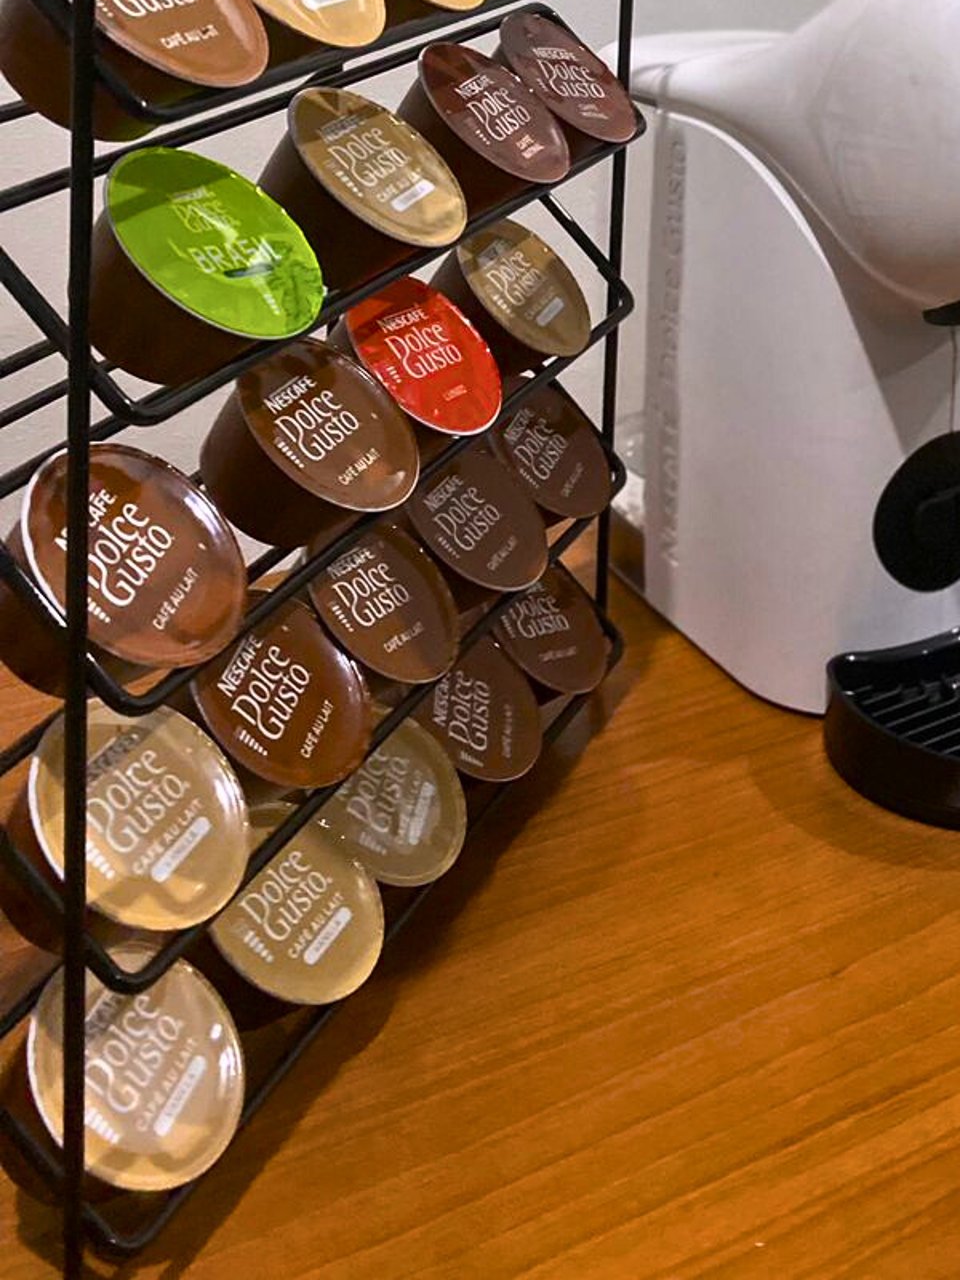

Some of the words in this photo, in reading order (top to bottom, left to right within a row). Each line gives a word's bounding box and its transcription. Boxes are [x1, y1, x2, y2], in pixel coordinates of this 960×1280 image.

[537, 59, 596, 81] Dolce
[549, 81, 605, 98] Gusto
[466, 88, 516, 123] Dolce
[485, 105, 531, 141] Gusto
[327, 128, 390, 169] Dolce
[351, 147, 409, 187] Gusto
[486, 251, 531, 291] Dolce
[384, 324, 449, 360] Dolce
[402, 344, 462, 378] Gusto
[274, 390, 343, 442] Dolce
[298, 410, 359, 460] Gusto
[514, 418, 553, 466] Dolce
[532, 434, 568, 480] Gusto
[433, 487, 485, 536] Dolce
[454, 504, 500, 551] Gusto
[100, 525, 172, 606] Gusto
[169, 588, 186, 610] AU
[181, 567, 198, 594] LAIT
[332, 563, 395, 607] Dolce
[352, 584, 409, 627] Gusto
[517, 614, 570, 638] Gusto
[231, 646, 290, 726] Dolce
[257, 664, 310, 740] Gusto
[448, 671, 473, 744] Dolce
[321, 699, 334, 723] LAIT
[470, 680, 490, 751] Gusto
[86, 750, 168, 832] Dolce
[106, 774, 186, 853] Gusto
[239, 851, 311, 924] Dolce
[263, 871, 328, 940] Gusto
[85, 995, 161, 1096] Dolce
[108, 1016, 182, 1113] Gusto
